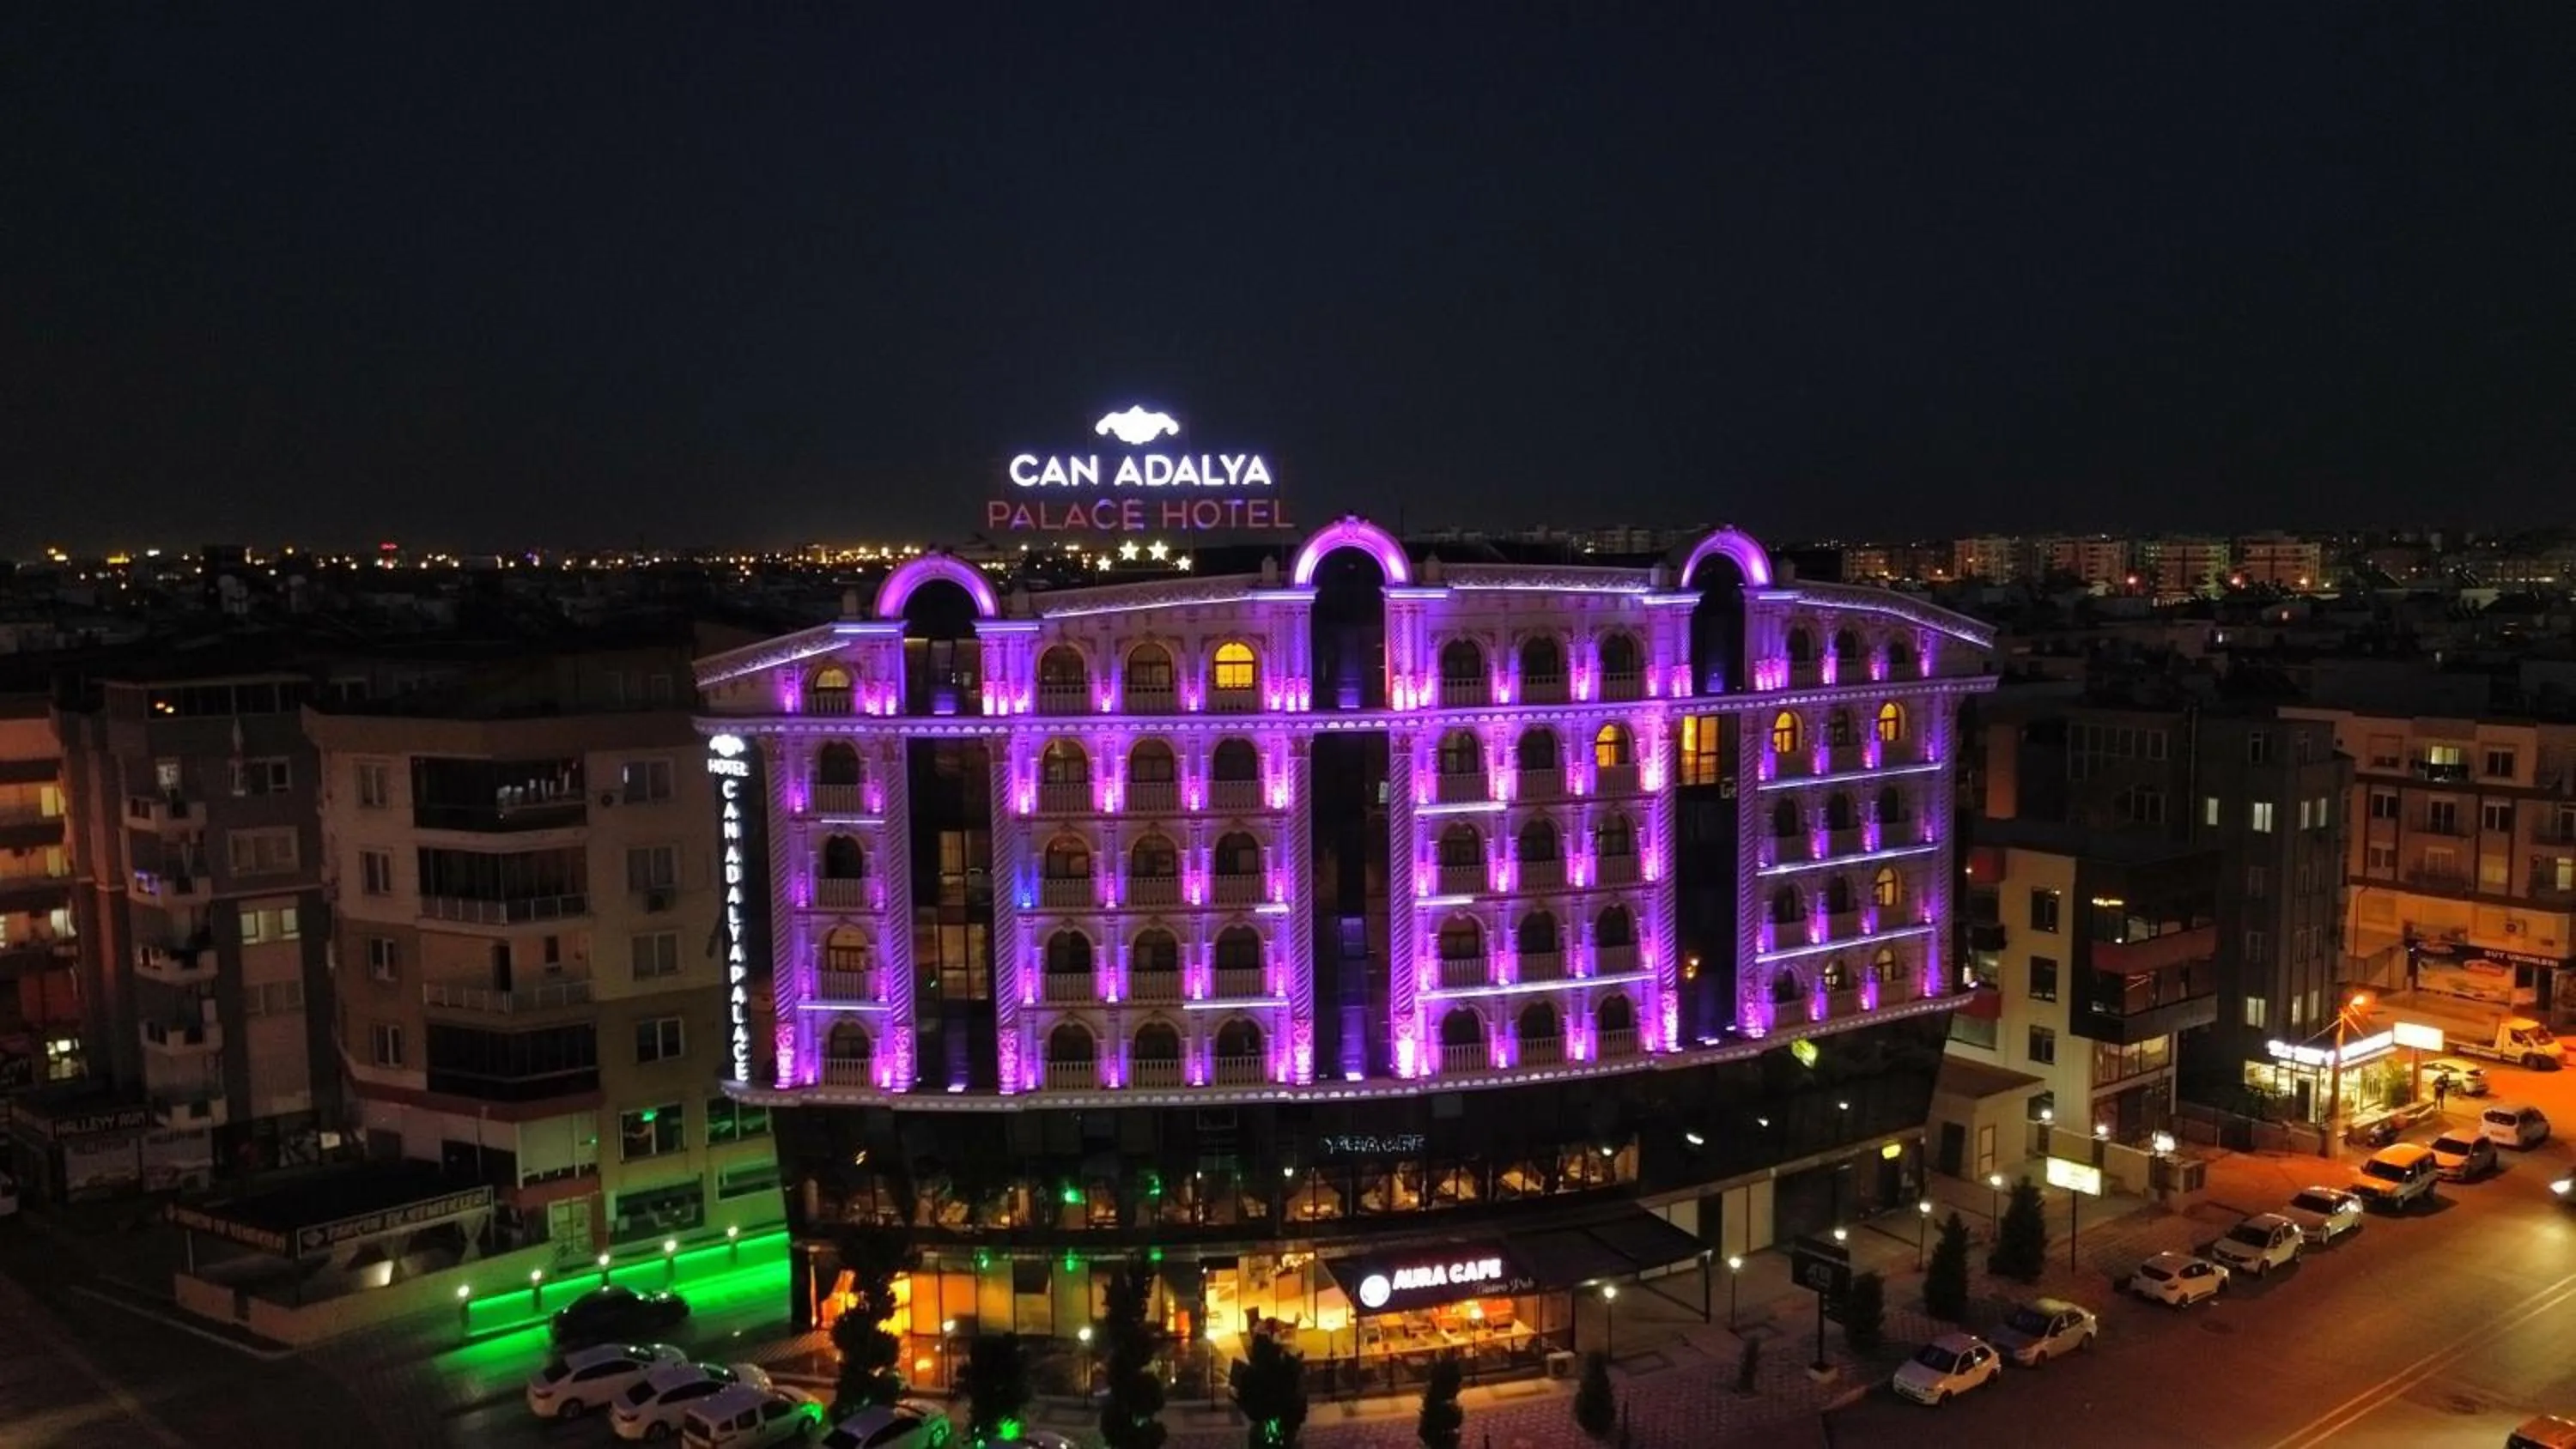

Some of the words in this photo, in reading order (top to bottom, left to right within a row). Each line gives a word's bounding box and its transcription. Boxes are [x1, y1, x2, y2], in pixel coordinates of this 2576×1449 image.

[1010, 454, 1098, 486] CAN
[1114, 454, 1271, 486] ADALYA
[987, 500, 1145, 530] PALACE
[1162, 500, 1294, 530] HOTEL
[708, 759, 749, 777] HOTEL
[722, 779, 742, 840] CAN
[726, 846, 745, 961] ADALYA
[730, 965, 750, 1082] PALACE
[1393, 1264, 1447, 1289] AURA
[1449, 1258, 1501, 1283] CAFE
